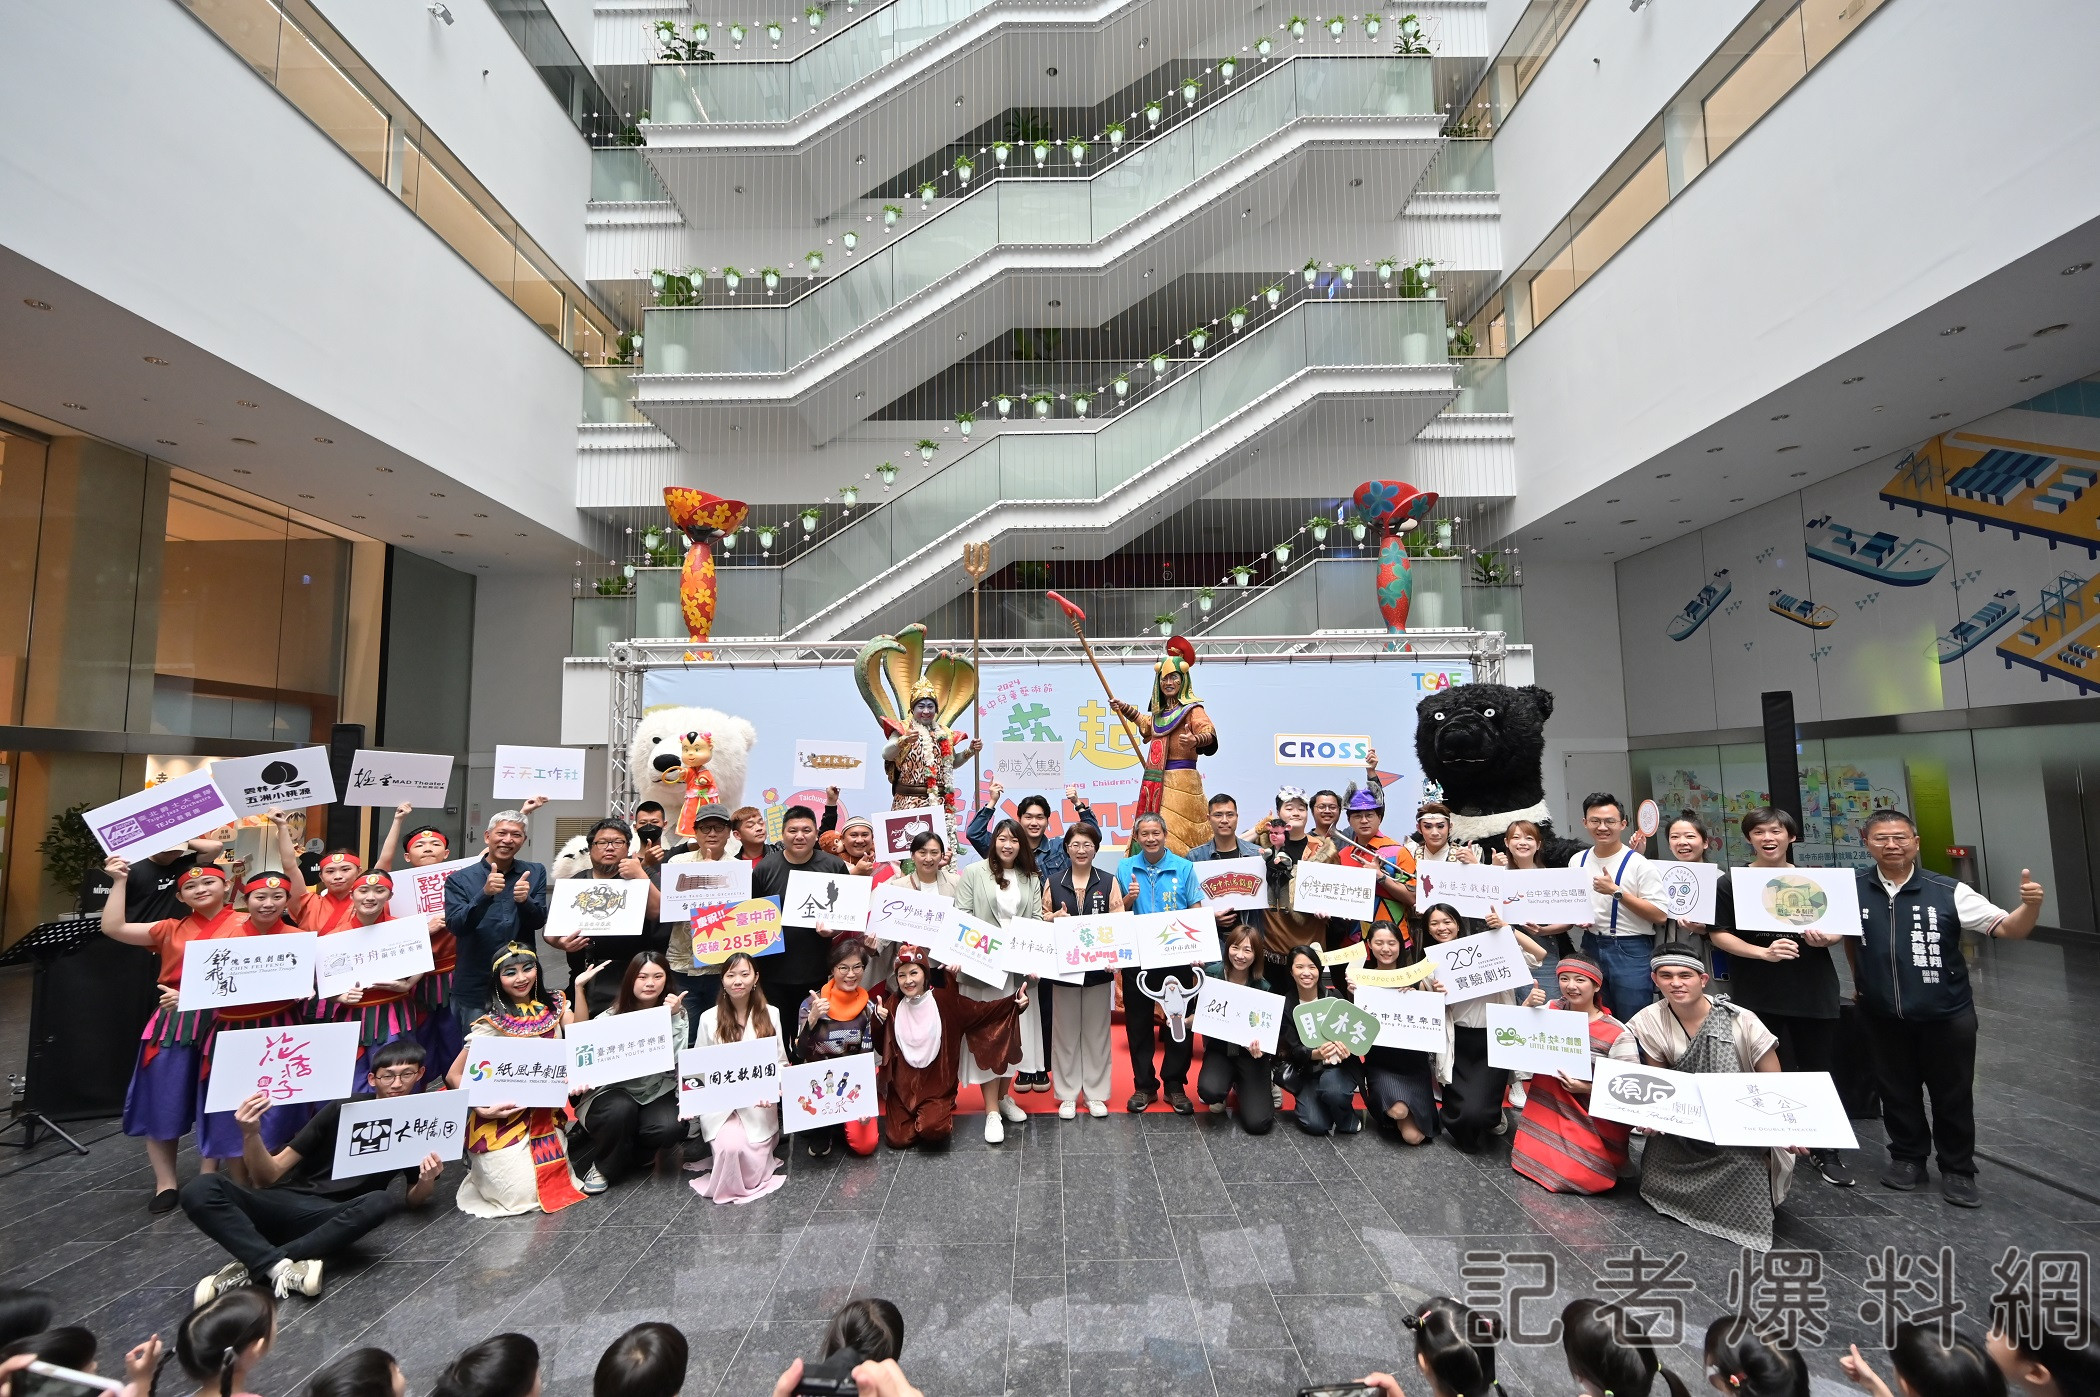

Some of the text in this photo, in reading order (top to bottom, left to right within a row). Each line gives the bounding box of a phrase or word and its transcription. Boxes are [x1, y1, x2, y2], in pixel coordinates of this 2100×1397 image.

[997, 678, 1021, 692] 2024
[1279, 741, 1367, 759] CROSS
[502, 766, 578, 780] 天天工作社
[244, 785, 269, 795] 雲林
[245, 787, 312, 805] 五洲小桃源
[138, 788, 212, 822] 臺北爵士大樂隊
[147, 795, 212, 824] Taipei Jazz Orchestra
[155, 817, 176, 829] TEJO
[1526, 889, 1587, 898] 台中室內合唱團
[797, 893, 828, 919] 金
[735, 908, 776, 927] 臺中市
[697, 930, 781, 954] 突破 285萬人
[958, 923, 1003, 955] TCAF
[1010, 936, 1057, 955] 臺中市政府
[1446, 945, 1482, 970] 20%
[1455, 966, 1512, 990] 實驗劇坊
[597, 1035, 666, 1057] 臺灣青年管樂團
[1529, 1042, 1545, 1050] LITTLE
[1561, 1046, 1582, 1054] THEATRE
[597, 1054, 620, 1063] TAIWAN
[625, 1049, 645, 1058] YOUTH
[495, 1062, 568, 1079] 紙風車劇團
